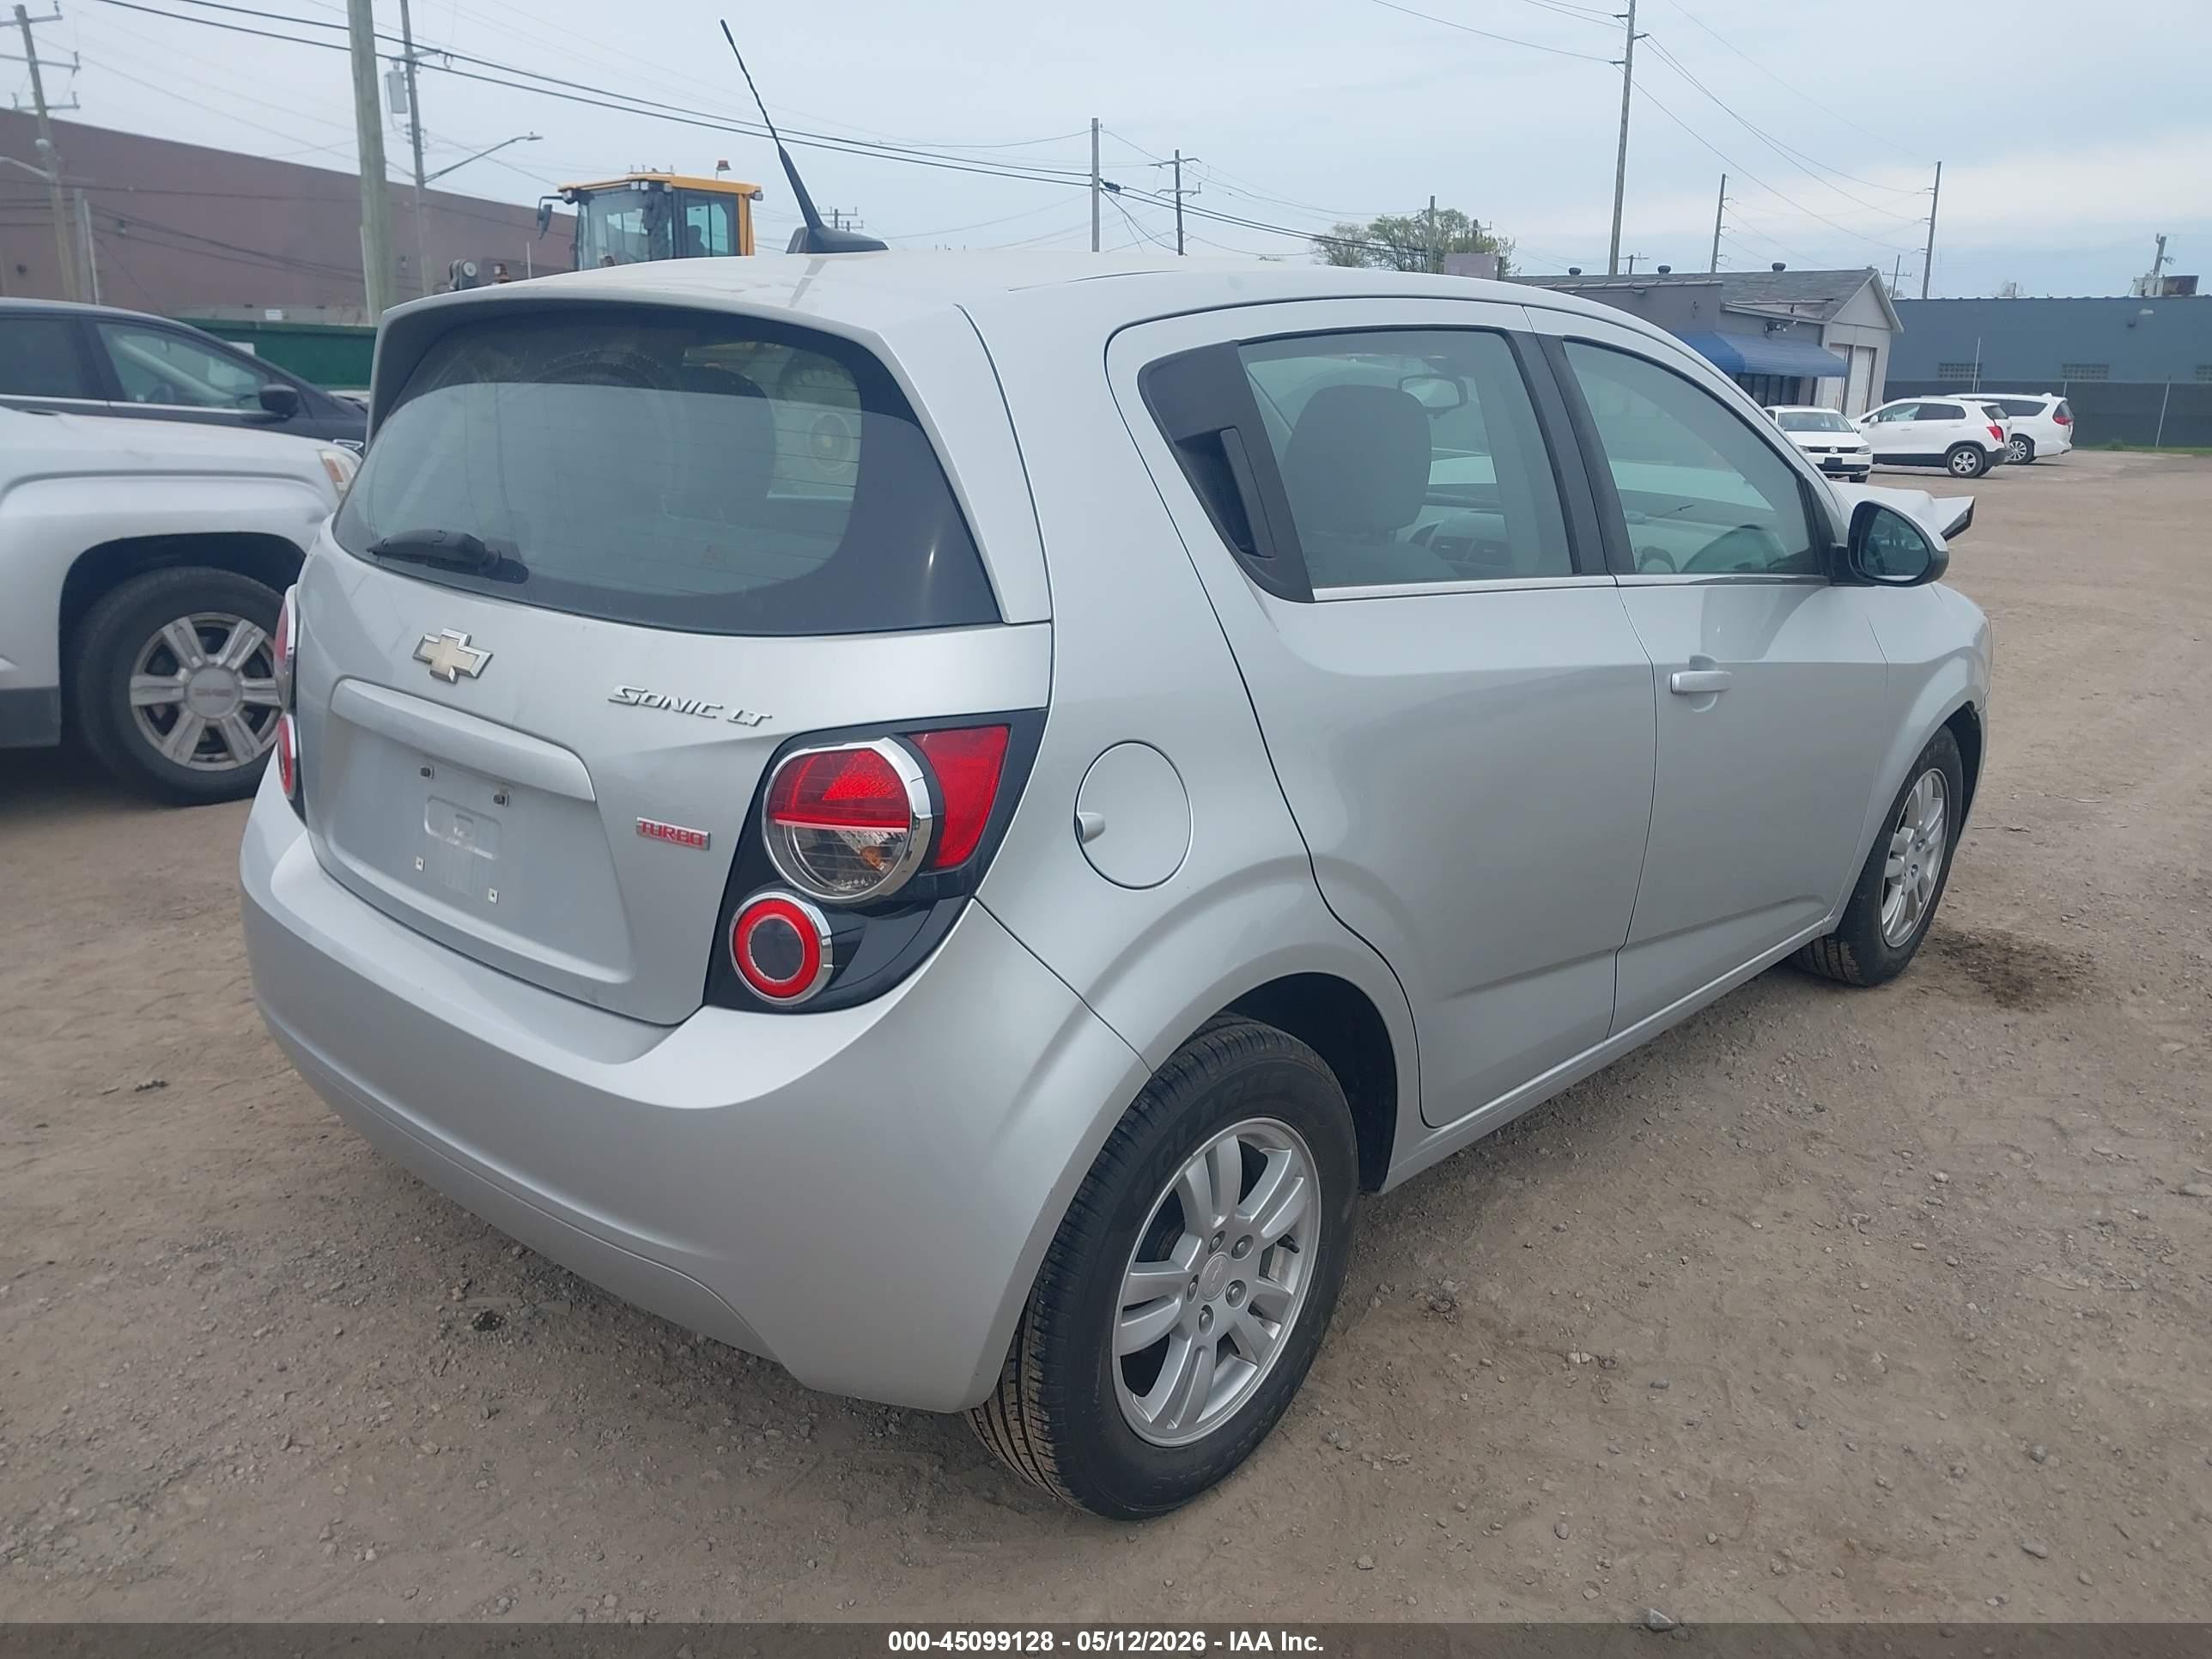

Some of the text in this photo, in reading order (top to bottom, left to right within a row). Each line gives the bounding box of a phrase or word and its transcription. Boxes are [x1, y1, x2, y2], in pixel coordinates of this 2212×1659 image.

[608, 684, 773, 727] SONIC LT
[639, 820, 704, 847] TURBO
